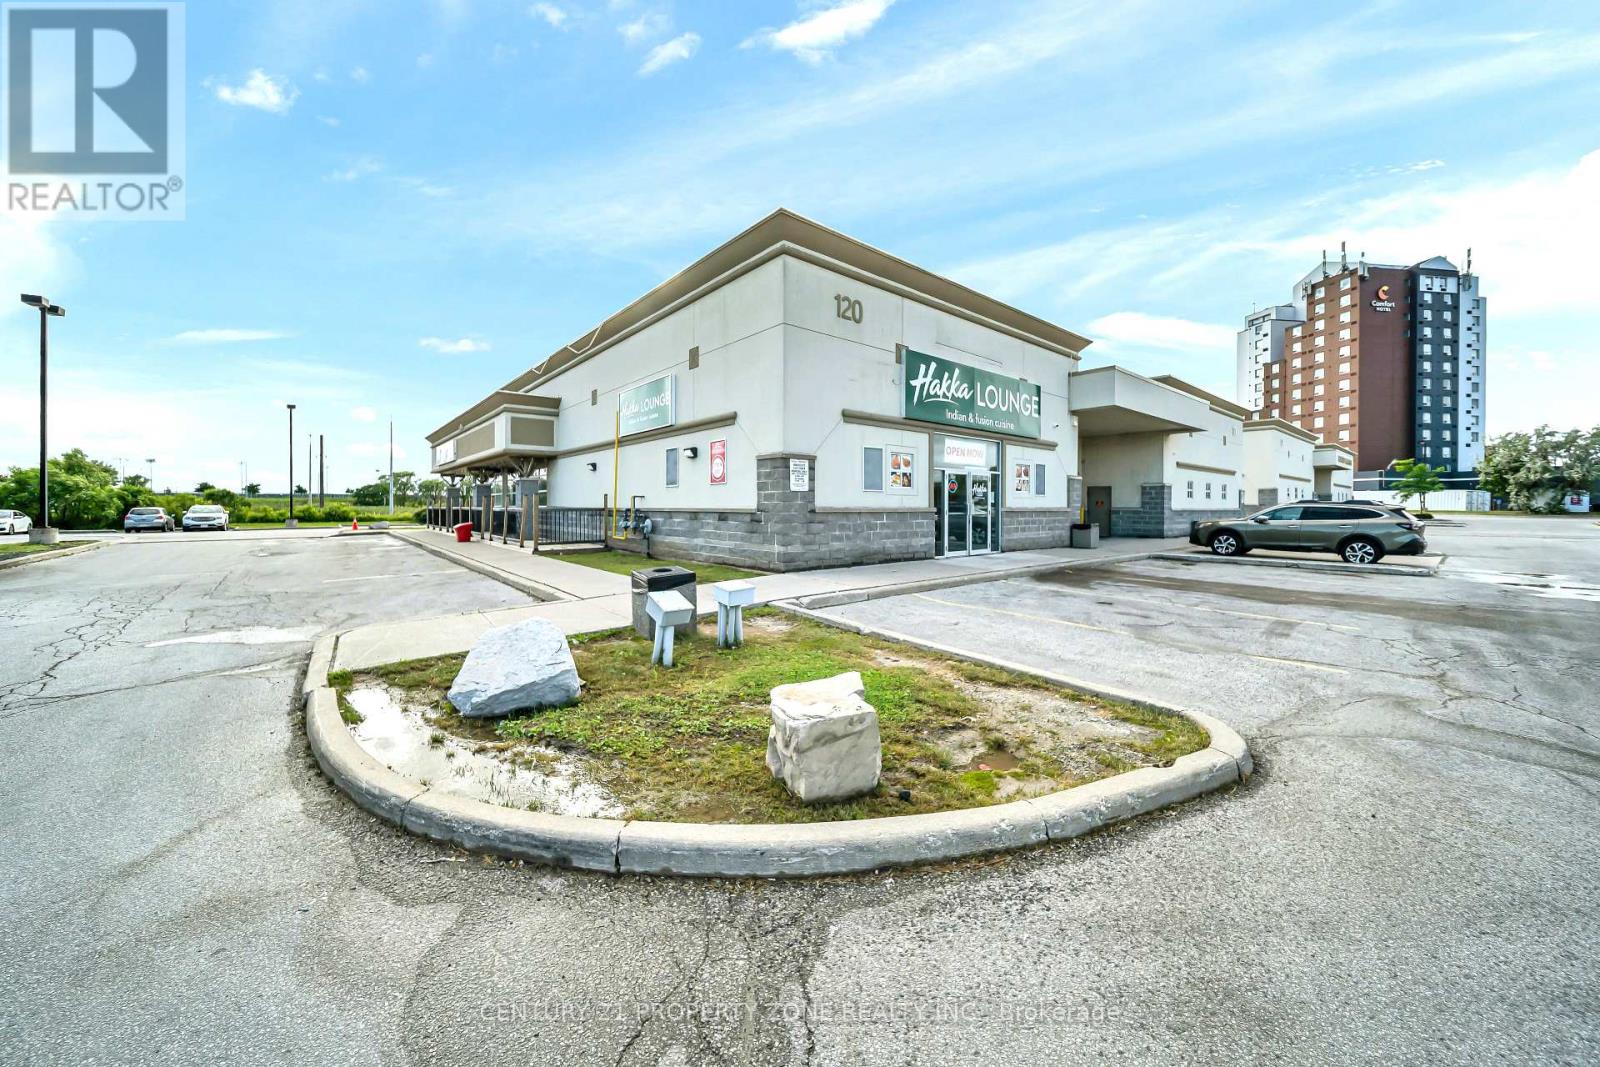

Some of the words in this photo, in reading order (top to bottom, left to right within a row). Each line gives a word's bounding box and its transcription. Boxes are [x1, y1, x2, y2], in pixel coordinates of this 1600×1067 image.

[834, 293, 864, 324] 120
[909, 361, 974, 406] Hakka
[976, 381, 1040, 418] LOUNGE
[945, 408, 967, 422] Indian
[968, 412, 974, 424] &
[975, 412, 994, 427] fusion
[994, 419, 1015, 431] cuisine
[946, 446, 965, 457] OPEN
